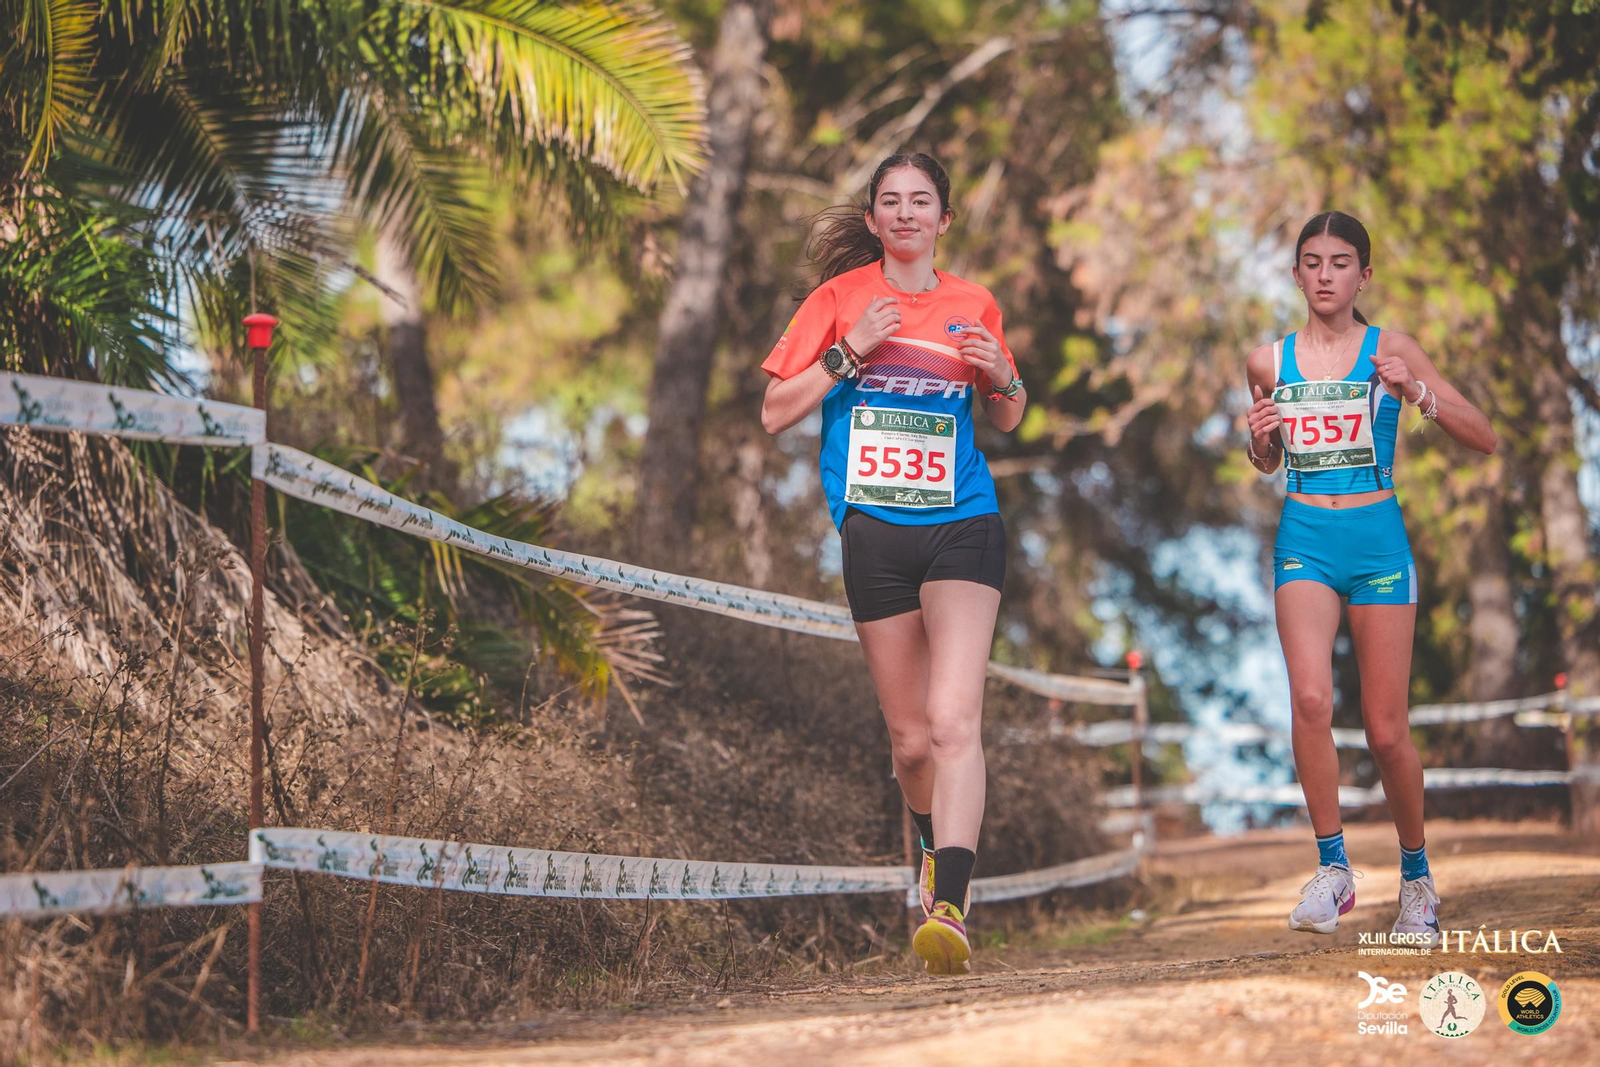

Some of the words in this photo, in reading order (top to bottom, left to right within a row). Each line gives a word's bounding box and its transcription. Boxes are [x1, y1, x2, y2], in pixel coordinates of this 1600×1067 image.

[855, 375, 968, 398] CAPA
[881, 412, 929, 428] ITÁLICA
[1282, 414, 1363, 446] 7557
[858, 446, 947, 482] 5535
